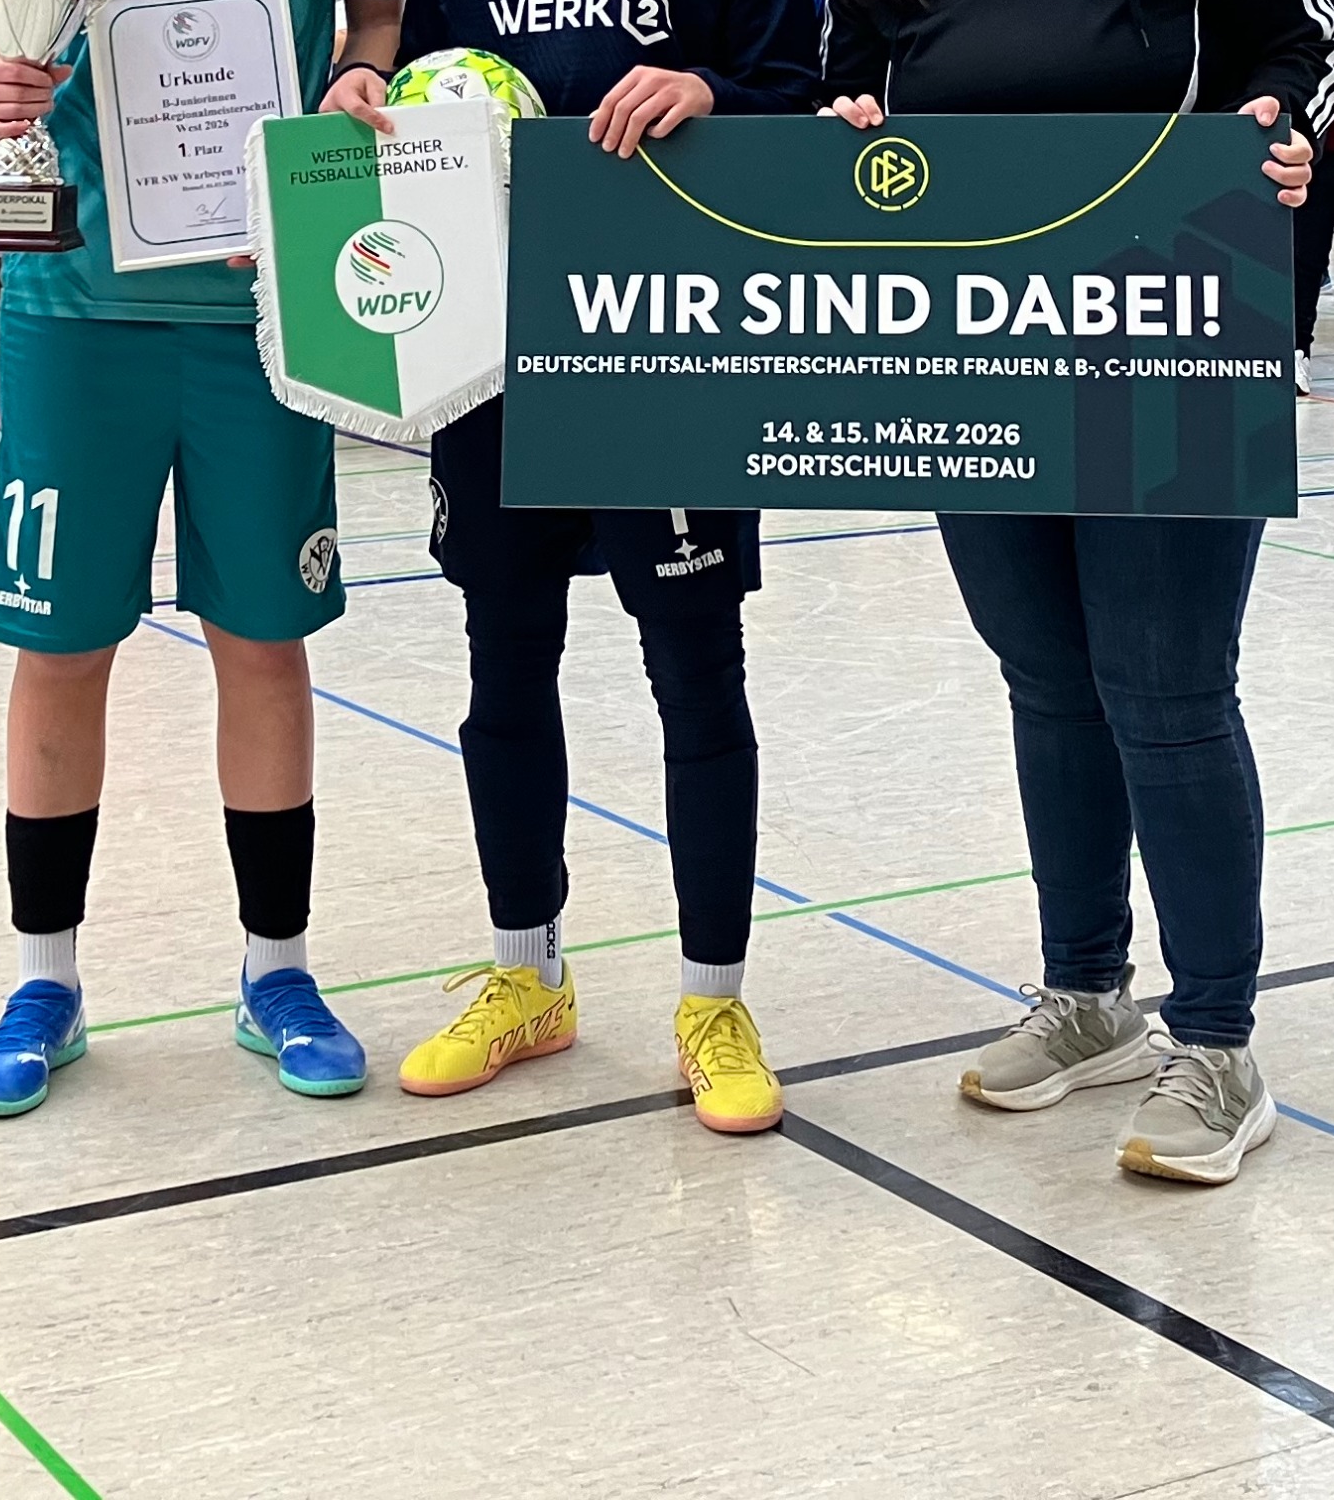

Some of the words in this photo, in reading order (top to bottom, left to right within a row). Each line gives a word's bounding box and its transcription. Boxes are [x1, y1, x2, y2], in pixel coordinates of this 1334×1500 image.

[175, 36, 211, 49] WDFV
[159, 67, 235, 88] Urkunde
[125, 100, 276, 127] Futsal-Regionalmeisterschaft
[162, 92, 237, 109] B-Juniorinnen
[175, 121, 202, 134] West
[204, 119, 230, 131] 2026
[194, 145, 224, 158] Platz
[310, 139, 444, 165] WESTDEUTSCHER
[135, 176, 159, 187] VFR
[161, 173, 180, 184] SW
[182, 167, 233, 181] Warbeyen
[290, 158, 437, 186] FUSSBALLVERBAND
[440, 155, 469, 171] E.V.
[357, 290, 432, 317] WDFV
[567, 274, 721, 335] WIR
[740, 272, 931, 335] SIND
[956, 274, 1222, 338] DABEI!
[517, 355, 626, 374] DEUTSCHE
[630, 355, 910, 376] FUTSAL-MEISTERSCHAFTEN
[915, 357, 959, 376] DER
[963, 357, 1049, 377] FRAUEN
[1054, 358, 1070, 377] &
[1075, 358, 1101, 379] B-,
[1104, 358, 1282, 379] C-JUNIORINNEN
[762, 421, 801, 444] 14.
[805, 421, 825, 444] &
[830, 421, 869, 444] 15.
[874, 417, 950, 446] MÄRZ
[955, 423, 1021, 446] 2026
[746, 453, 932, 479] SPORTSCHULE
[936, 455, 1036, 480] WEDAU
[2, 478, 59, 581] 11
[655, 548, 725, 578] DERBYSTAR
